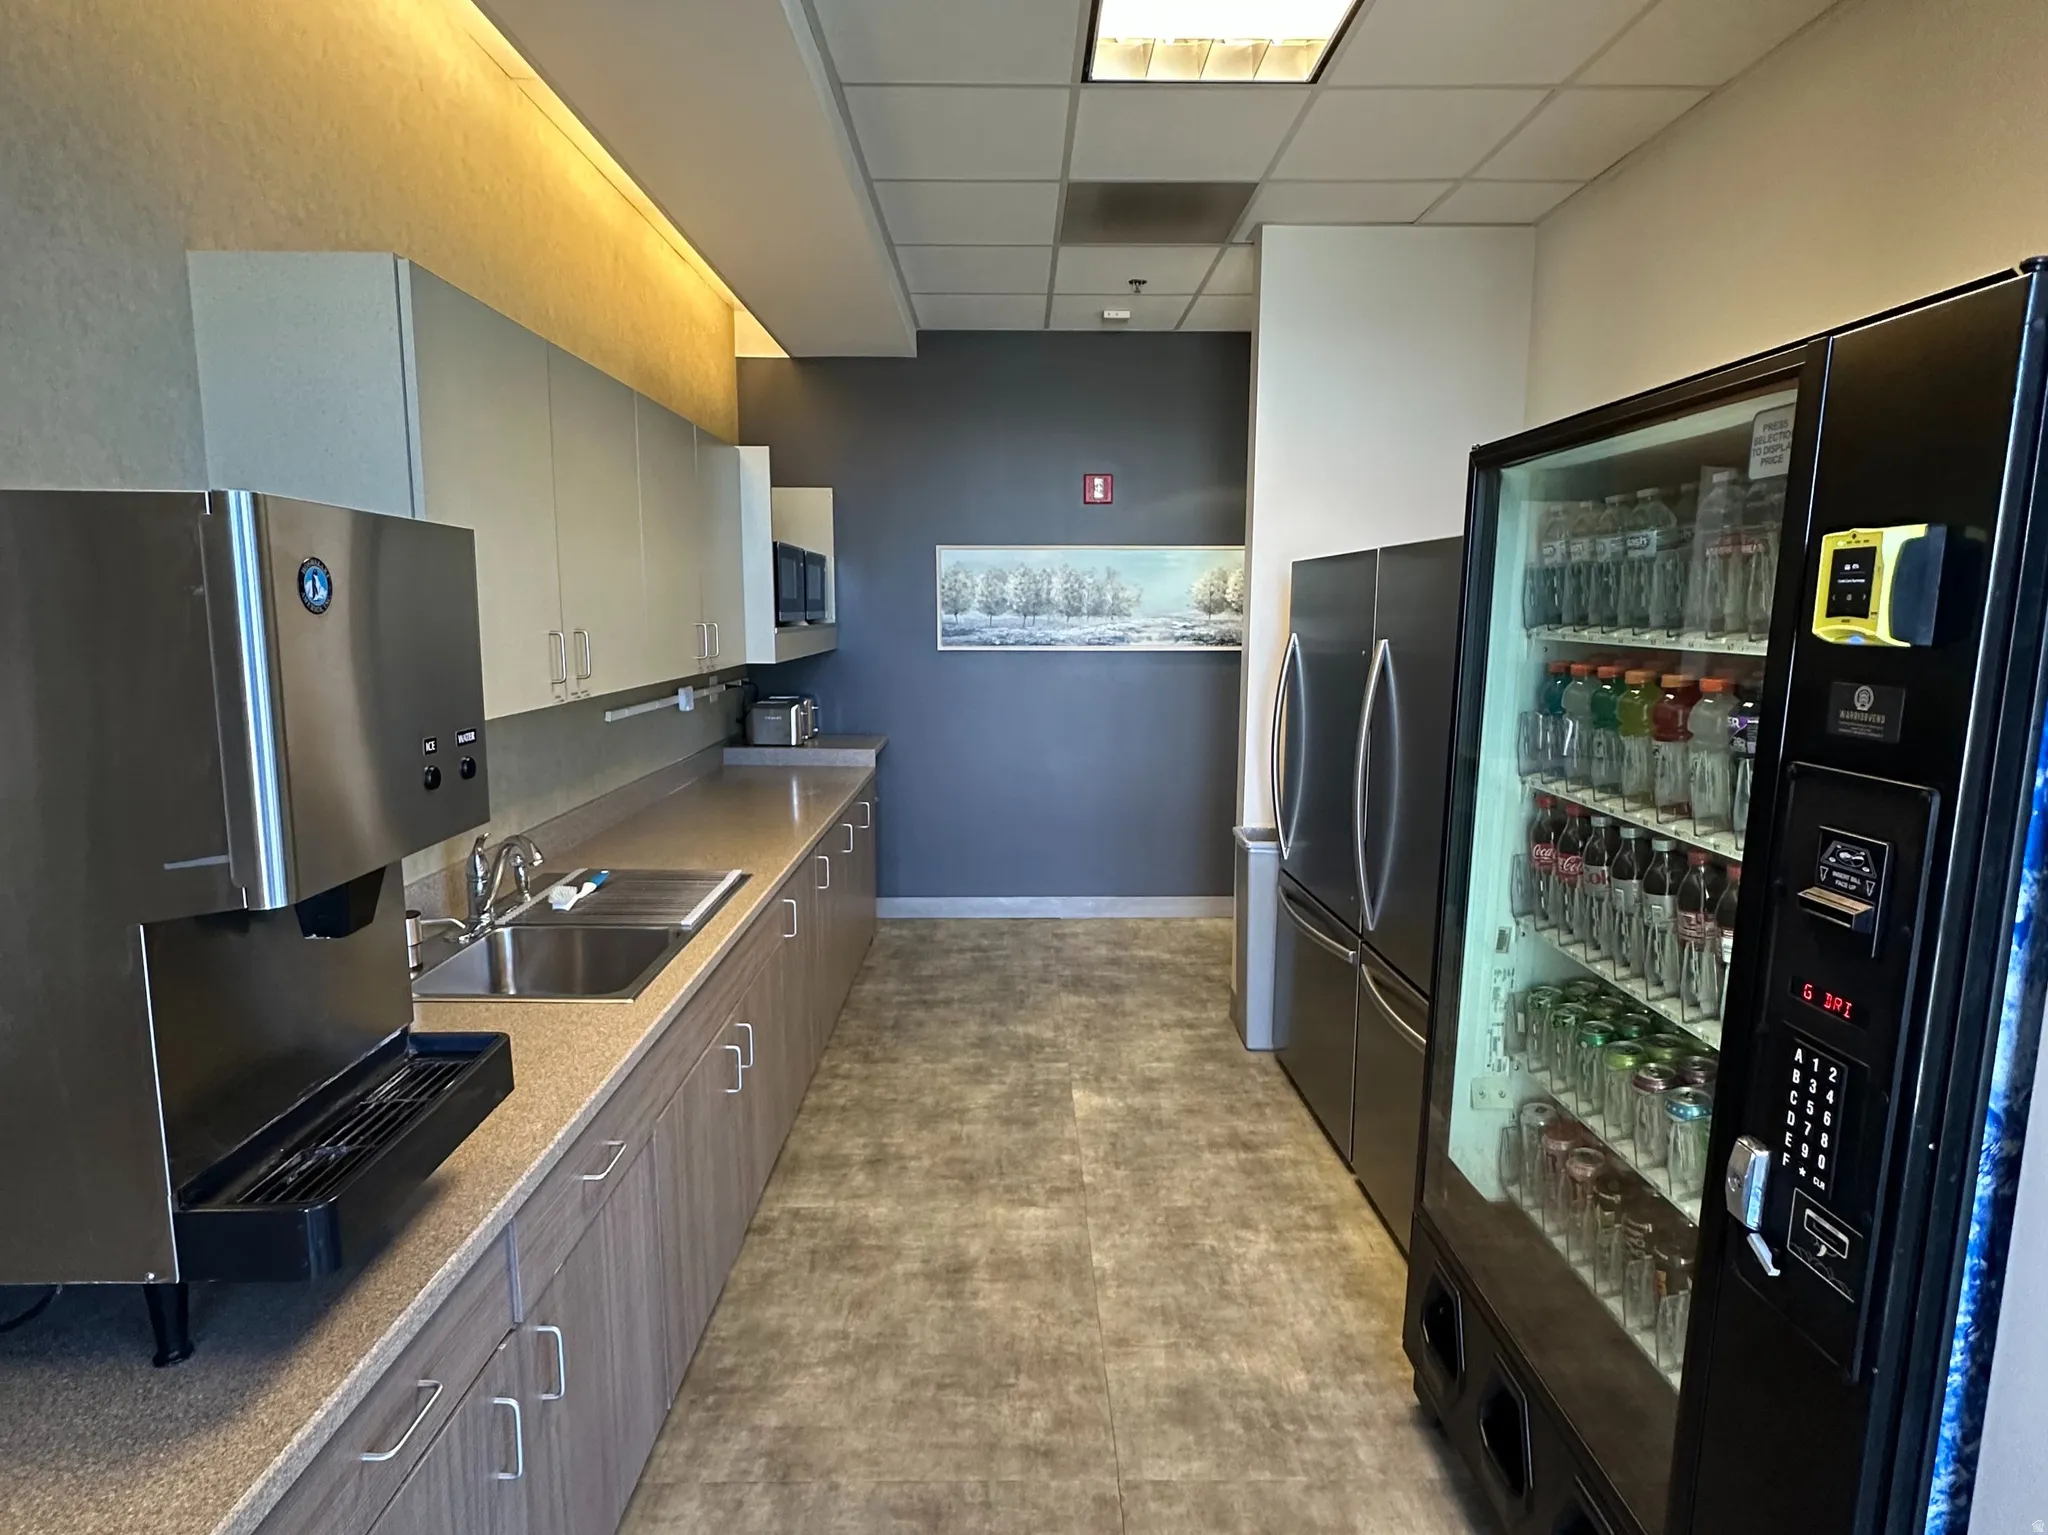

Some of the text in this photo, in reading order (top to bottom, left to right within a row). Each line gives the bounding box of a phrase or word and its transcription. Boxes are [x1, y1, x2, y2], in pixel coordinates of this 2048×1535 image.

[1762, 420, 1789, 433] PRESS
[1753, 430, 1792, 446] SELECTIO
[1752, 442, 1791, 457] TO DISPLA
[1760, 453, 1784, 467] PRICE
[425, 740, 436, 752] ICE
[457, 731, 476, 744] WATER
[1803, 983, 1813, 1000] G
[1794, 1047, 1838, 1083] A 1 2
[1792, 1068, 1834, 1105] B 3 4
[1790, 1089, 1832, 1127] C 5 6
[1786, 1109, 1829, 1148] D 7 8
[1784, 1131, 1826, 1170] E 9 0
[1782, 1151, 1826, 1191] F CLR
